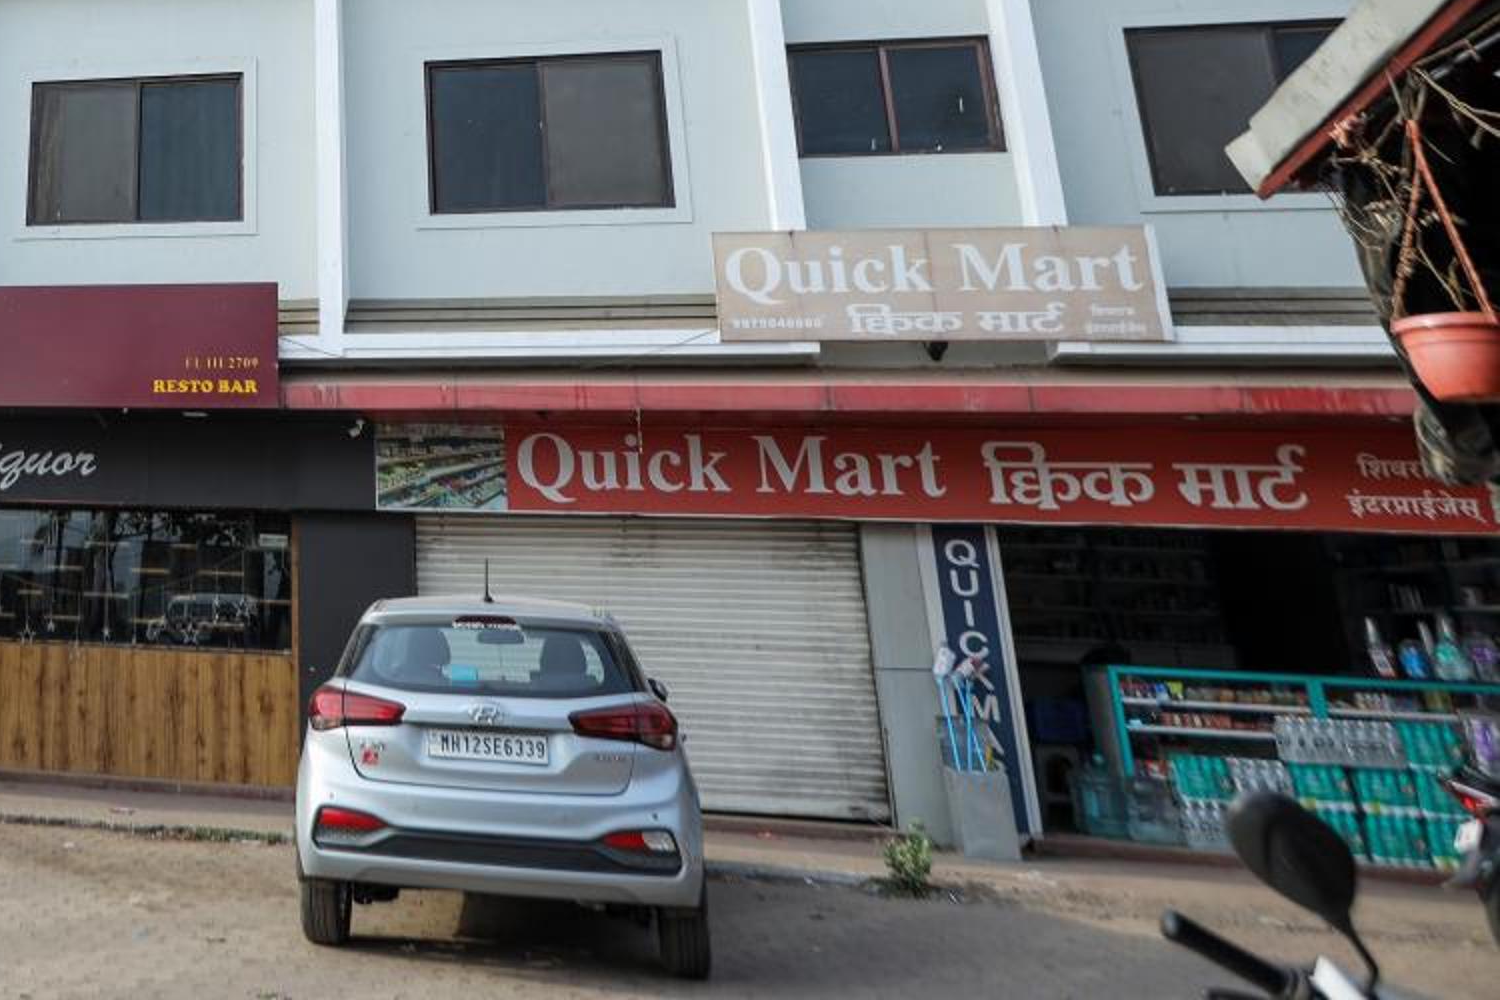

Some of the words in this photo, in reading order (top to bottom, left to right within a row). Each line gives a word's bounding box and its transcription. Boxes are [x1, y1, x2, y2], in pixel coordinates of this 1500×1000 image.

[724, 243, 933, 305] Quick
[949, 242, 1145, 293] Mart
[153, 379, 214, 393] RESTO
[218, 379, 258, 393] BAR
[515, 432, 733, 504] Quick
[749, 435, 948, 499] Mart
[1172, 444, 1308, 511] मार्ट
[439, 734, 546, 760] MH12SE6339
